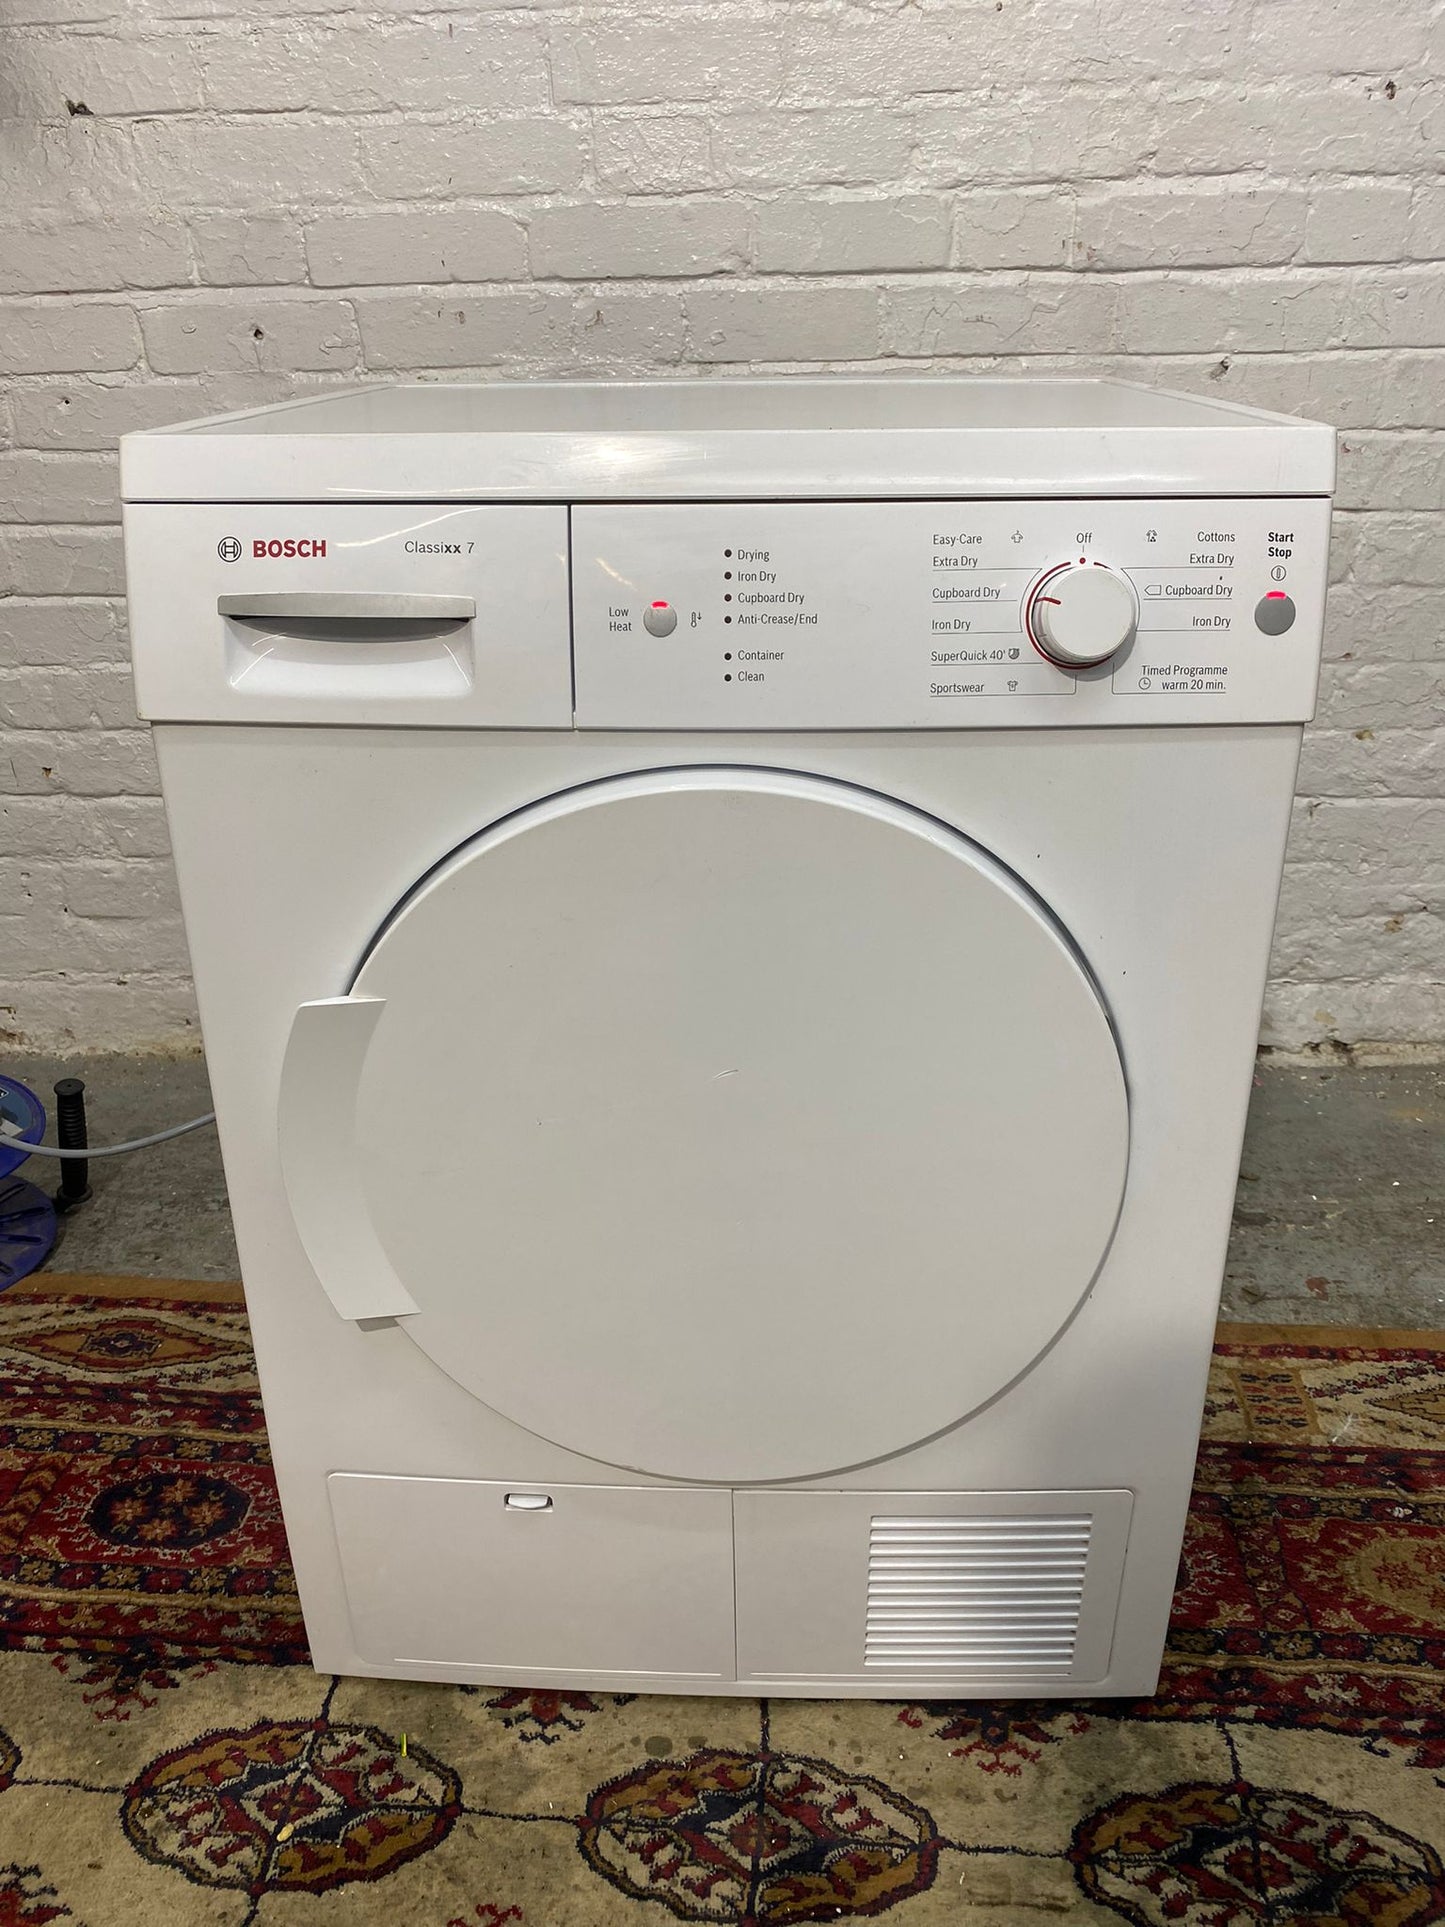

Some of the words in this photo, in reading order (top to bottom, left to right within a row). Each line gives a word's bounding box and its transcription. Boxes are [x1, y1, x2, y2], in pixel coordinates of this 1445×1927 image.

[1075, 532, 1093, 544] Off
[1197, 531, 1236, 543] Cottons
[1267, 531, 1295, 543] Start
[253, 539, 327, 558] BOSCH
[404, 540, 461, 555] Classixx
[466, 541, 475, 555] 7
[1267, 546, 1293, 559] Stop
[737, 549, 770, 563] Drying
[933, 556, 958, 567] Extra
[960, 555, 979, 569] Dry
[1189, 553, 1215, 565] Extra
[1217, 553, 1235, 567] Dry
[737, 570, 757, 582] Iron
[759, 570, 777, 584] Dry
[932, 587, 981, 600] Cupboard
[983, 586, 1001, 600] Dry
[1165, 584, 1214, 598] Cupboard
[1215, 584, 1233, 598] Dry
[737, 592, 785, 605] Cupboard
[788, 592, 805, 605] Dry
[609, 606, 629, 618] Low
[737, 613, 818, 626] Anti-Crease/End
[931, 618, 951, 630] Iron
[953, 618, 971, 632] Dry
[1192, 616, 1210, 627] Iron
[1213, 616, 1231, 629] Dry
[609, 621, 632, 632] Heat
[737, 650, 785, 661] Container
[930, 649, 988, 662] SuperQuick
[737, 671, 765, 682] Clean
[1141, 664, 1171, 676] Timed
[1172, 664, 1228, 678] Programme
[930, 681, 985, 695] Sportswear
[1161, 681, 1189, 691] warm
[1190, 679, 1204, 690] 20
[1205, 679, 1227, 691] min.
